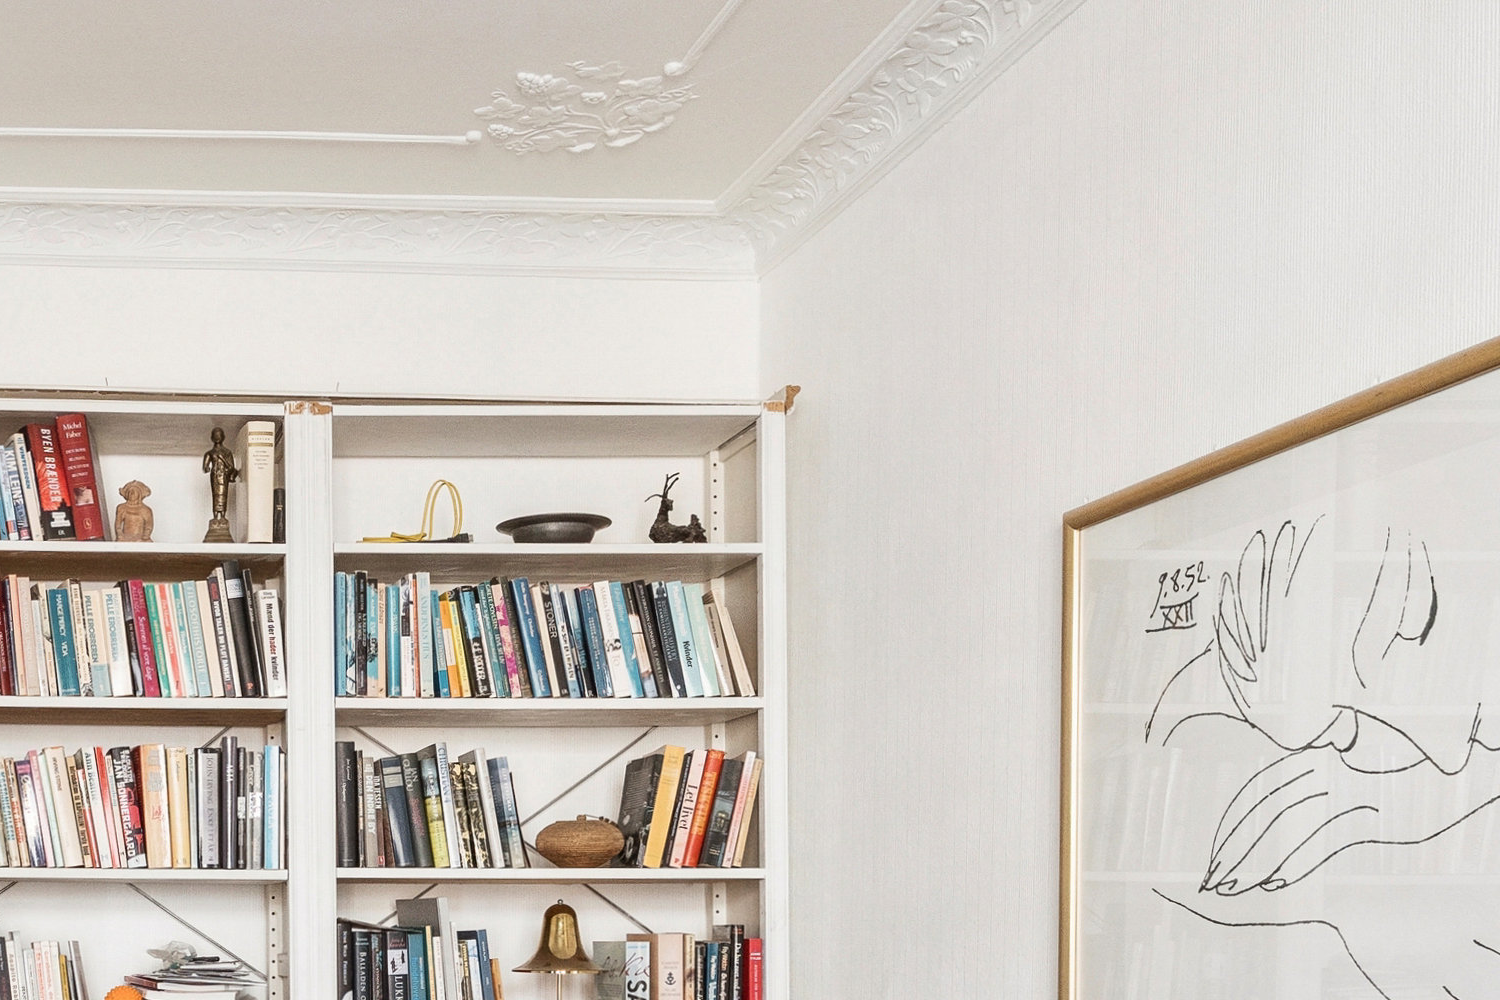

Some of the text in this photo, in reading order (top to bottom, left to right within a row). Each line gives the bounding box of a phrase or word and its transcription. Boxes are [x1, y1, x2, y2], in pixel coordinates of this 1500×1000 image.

[4, 450, 15, 471] KIM
[40, 428, 62, 502] BYEN BRÆNDER
[85, 596, 98, 663] PELLE EROBREREN
[544, 602, 557, 638] STONER
[138, 616, 150, 643] Summen
[145, 666, 154, 681] dage
[266, 603, 275, 623] Mænd
[271, 656, 279, 680] kvinder
[668, 637, 677, 660] MISTRY
[683, 641, 693, 668] Kvinder
[113, 759, 123, 782] JAN
[437, 747, 450, 797] CHRISTIAN
[206, 779, 214, 804] IRVING
[366, 775, 375, 835] DEN INDRE BY
[678, 807, 694, 831] livet
